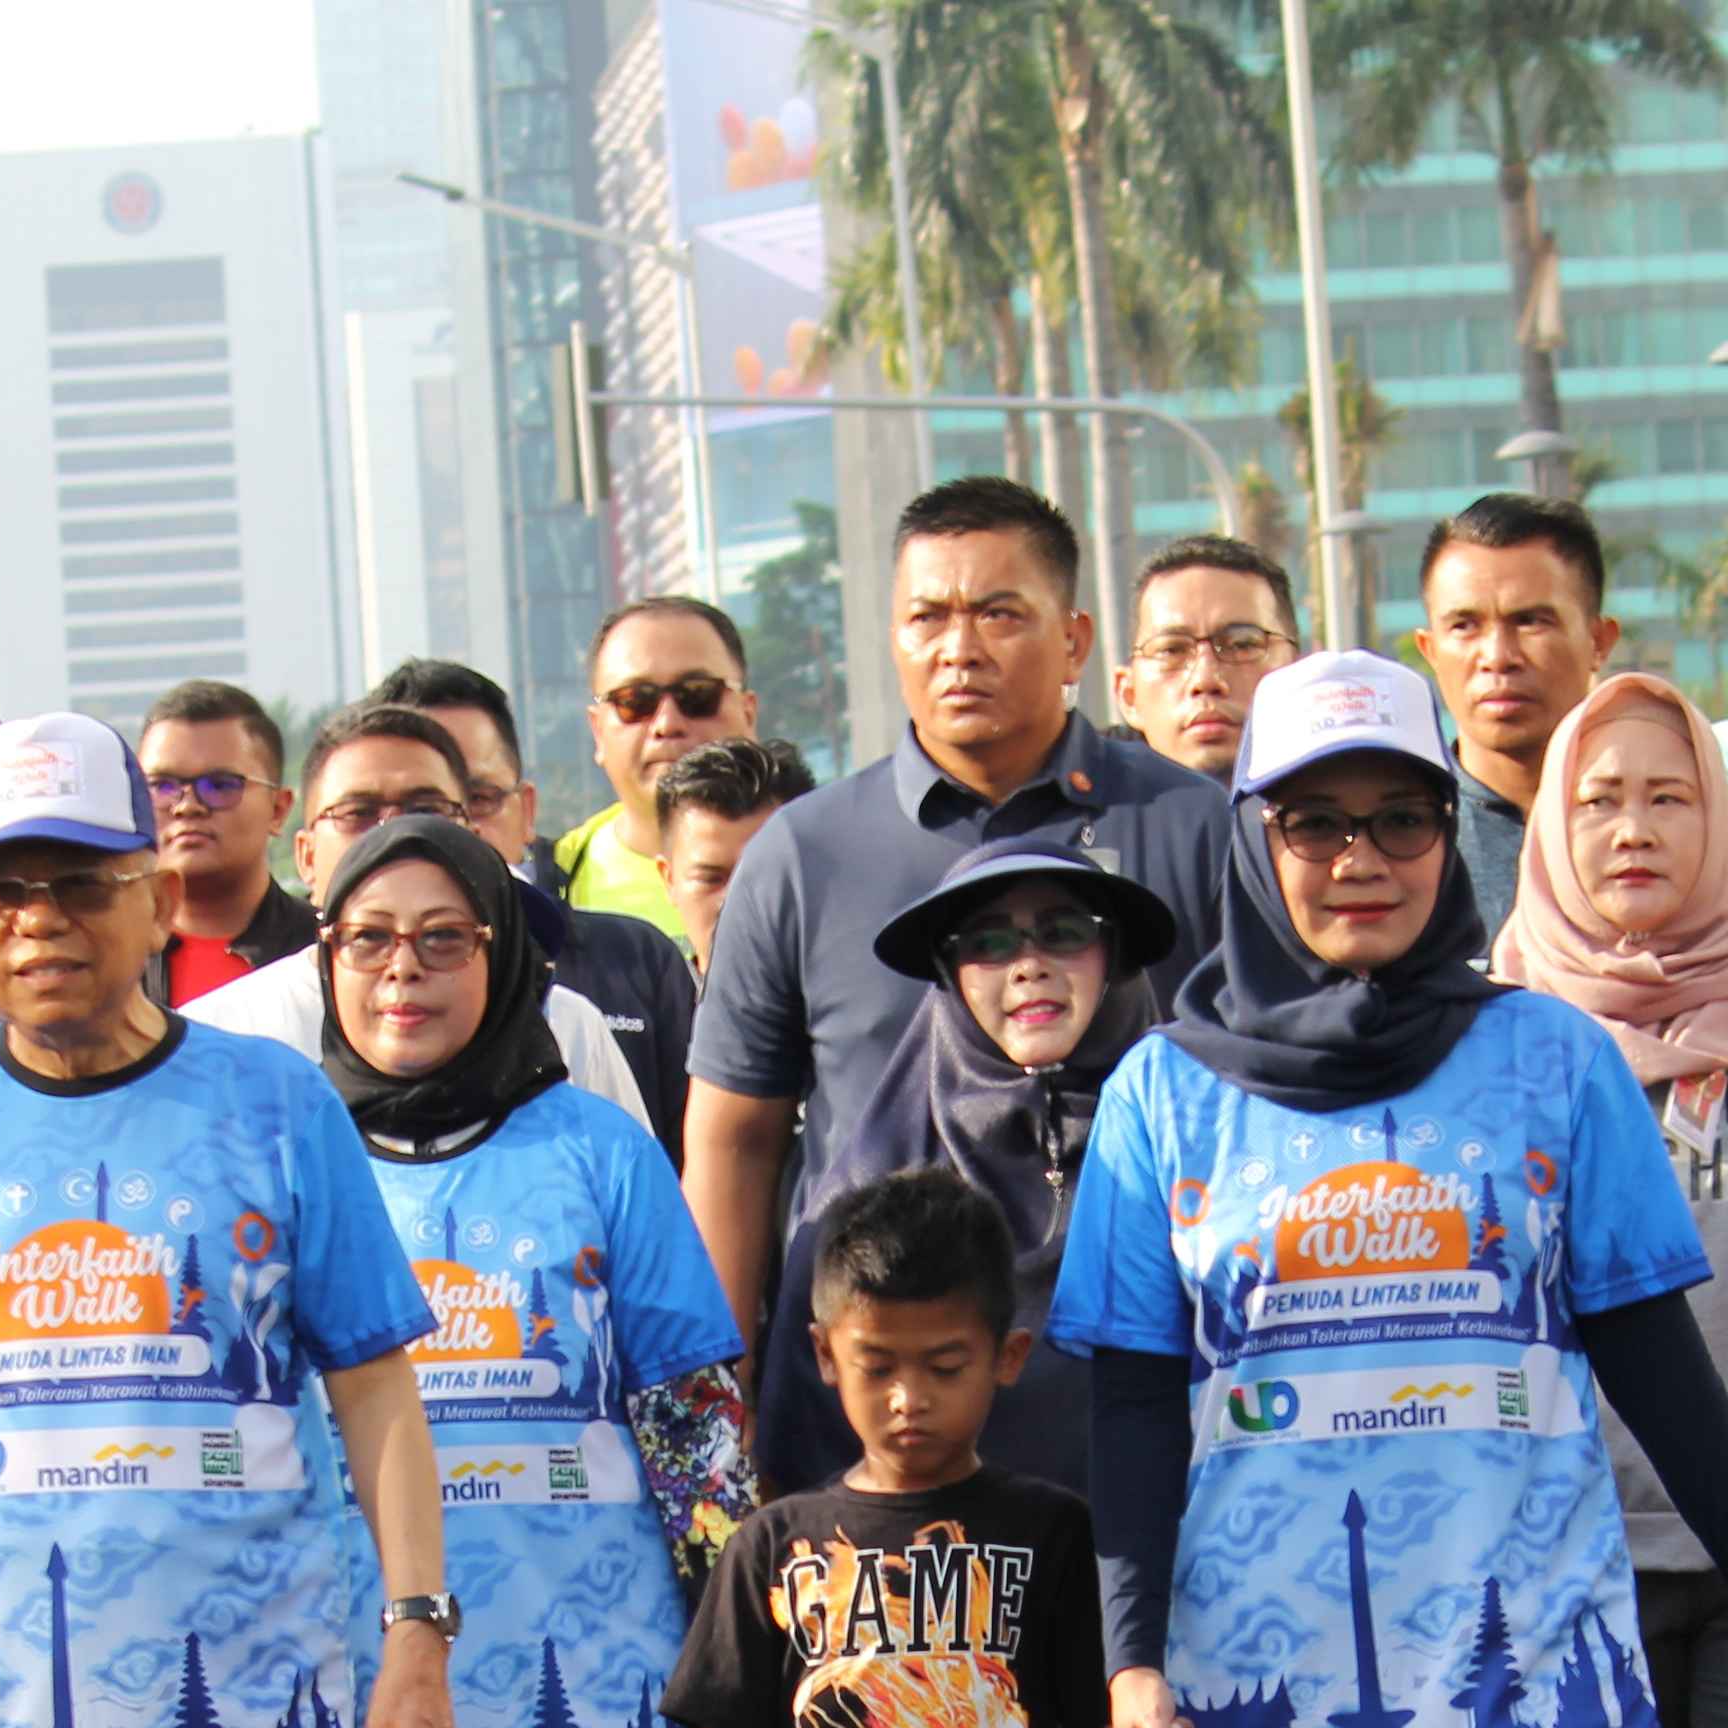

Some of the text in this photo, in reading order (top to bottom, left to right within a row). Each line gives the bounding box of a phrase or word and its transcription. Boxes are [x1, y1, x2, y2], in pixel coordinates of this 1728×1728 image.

[1258, 1171, 1478, 1230] Interfaith
[1297, 1217, 1441, 1269] Walk
[10, 1279, 145, 1329] Walk
[422, 1270, 527, 1322] faith
[1262, 1280, 1480, 1317] PEMUDA LINTAS IMAN
[403, 1312, 494, 1354] alk
[1310, 1322, 1382, 1344] Toleransi
[1384, 1320, 1454, 1341] Merawat
[59, 1346, 126, 1369] LINTAS
[132, 1344, 183, 1366] IMAN
[20, 1386, 89, 1403] Toleransi
[91, 1383, 159, 1401] Merawat
[483, 1367, 534, 1388] IMAN
[443, 1404, 508, 1420] Merawat
[1332, 1400, 1446, 1433] mandiri
[38, 1460, 149, 1488] mandiri
[442, 1476, 501, 1501] ndiri
[782, 1543, 1034, 1668] GAME
